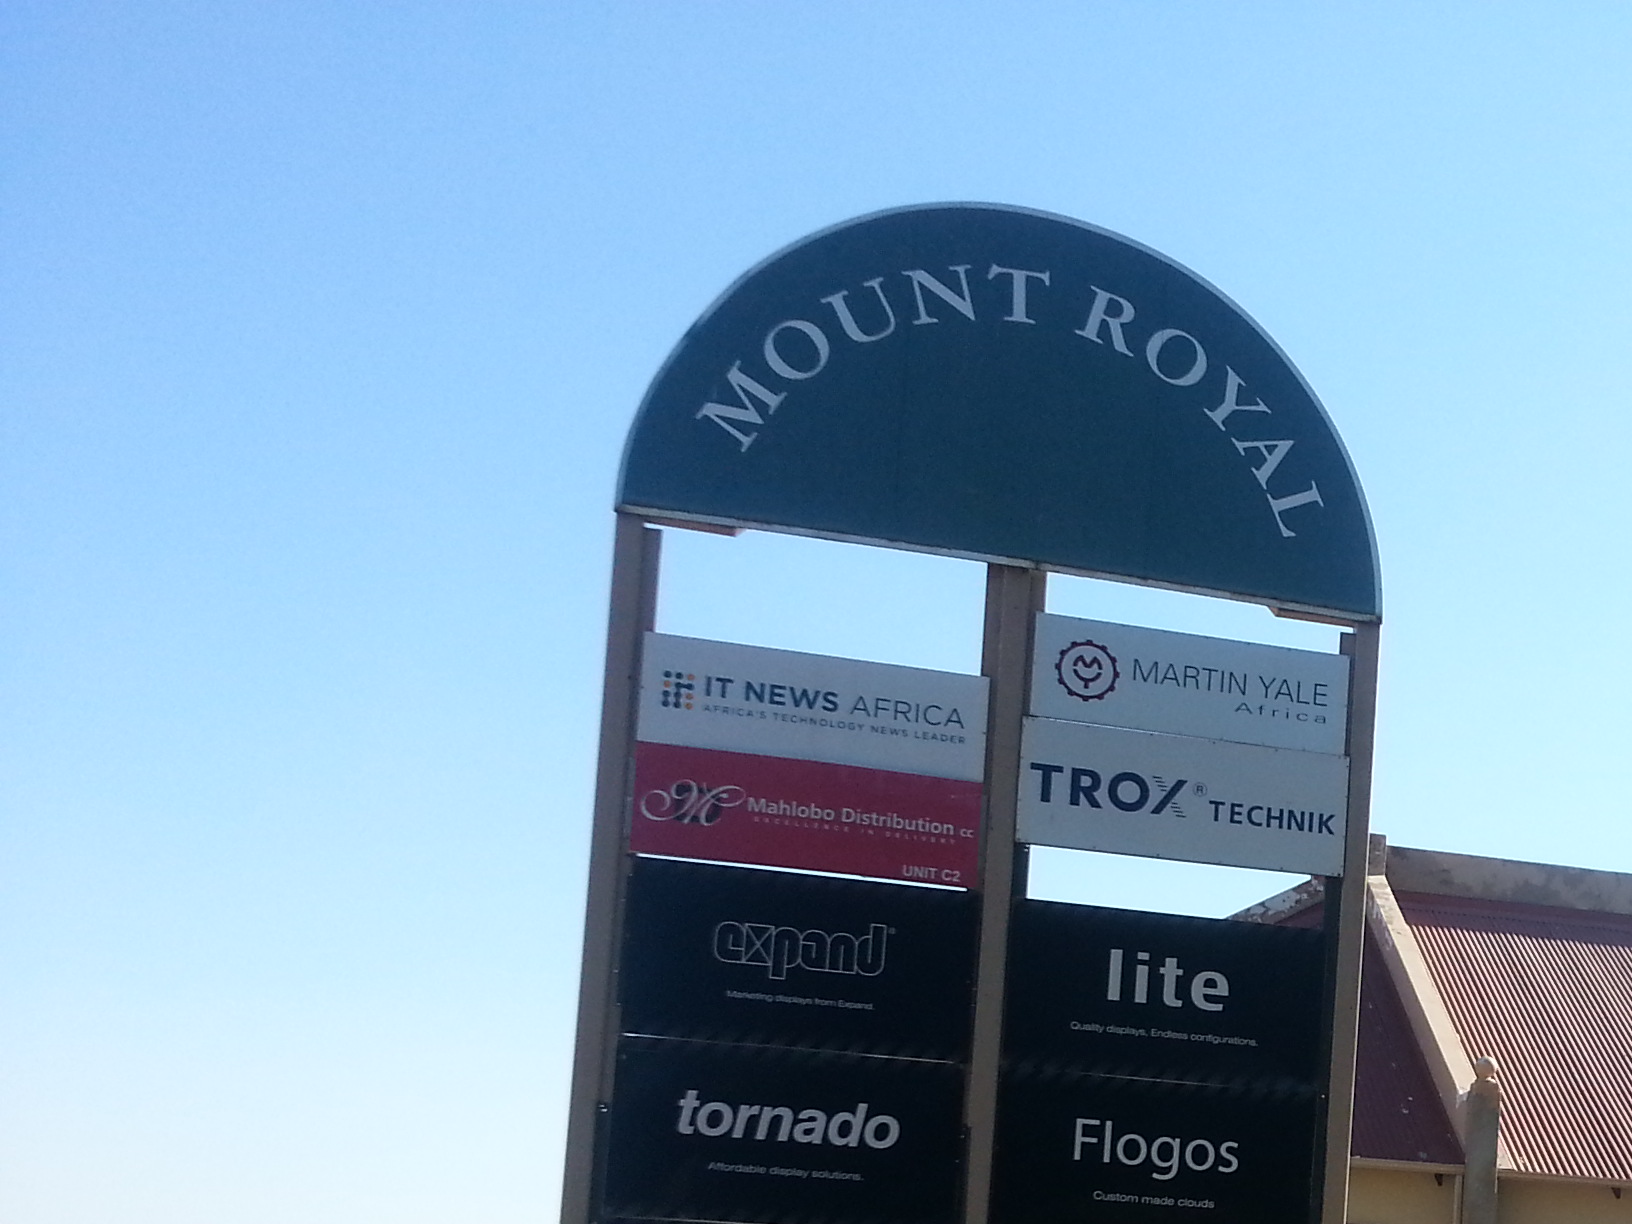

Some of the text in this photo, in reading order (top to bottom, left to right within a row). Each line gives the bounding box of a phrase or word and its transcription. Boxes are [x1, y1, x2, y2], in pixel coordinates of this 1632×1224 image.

[695, 263, 1325, 539] MOUNT ROYAL
[703, 675, 965, 730] IT NEWS AFRICA
[1132, 658, 1329, 708] MARTIN YALE
[703, 704, 967, 745] AFRICA'S TECHNOLOGY NEWS LEADER
[1234, 702, 1327, 725] Africa
[747, 796, 836, 822] Mahlobo
[841, 806, 955, 837] Distribution
[1030, 762, 1337, 836] TROX TECHNIK
[902, 864, 961, 883] UNIT C2
[714, 920, 888, 981] expand
[814, 997, 837, 1008] from
[1106, 948, 1230, 1012] lite
[1070, 1020, 1105, 1034] Quality
[1150, 1027, 1188, 1040] Endless
[677, 1089, 901, 1149] tornado
[707, 1161, 768, 1175] Affordable
[768, 1165, 810, 1179] display
[1073, 1117, 1239, 1180] Flogos
[1093, 1190, 1216, 1209] Custom made clouds
